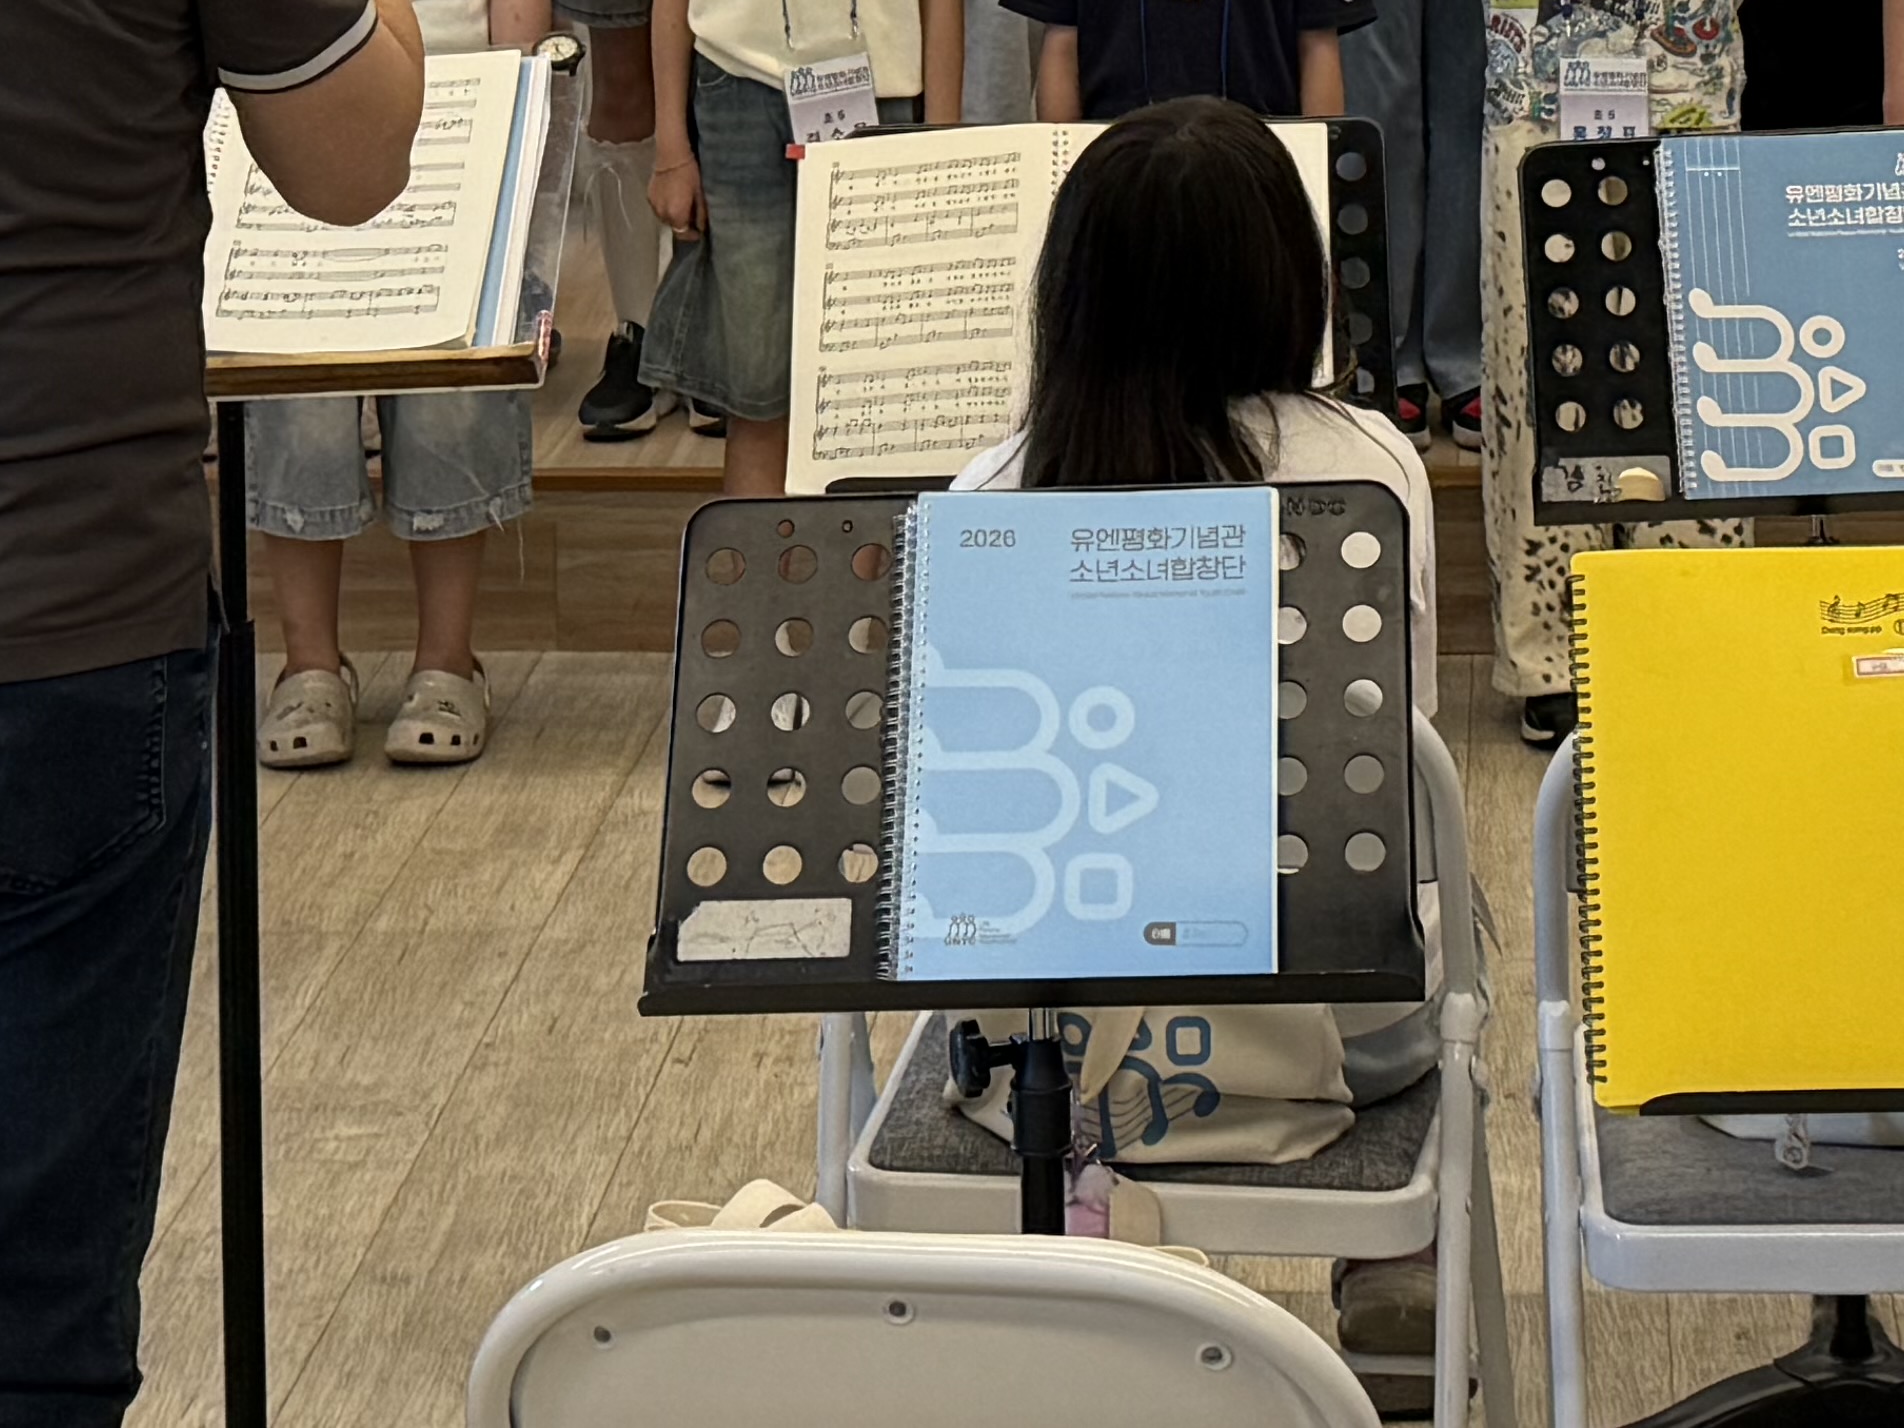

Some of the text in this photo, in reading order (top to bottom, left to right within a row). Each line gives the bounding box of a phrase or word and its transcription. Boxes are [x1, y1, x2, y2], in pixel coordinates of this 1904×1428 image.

[959, 528, 1017, 548] 2026
[1069, 523, 1246, 554] 유엔평화기념관
[1068, 554, 1246, 584] 소년소녀합창단
